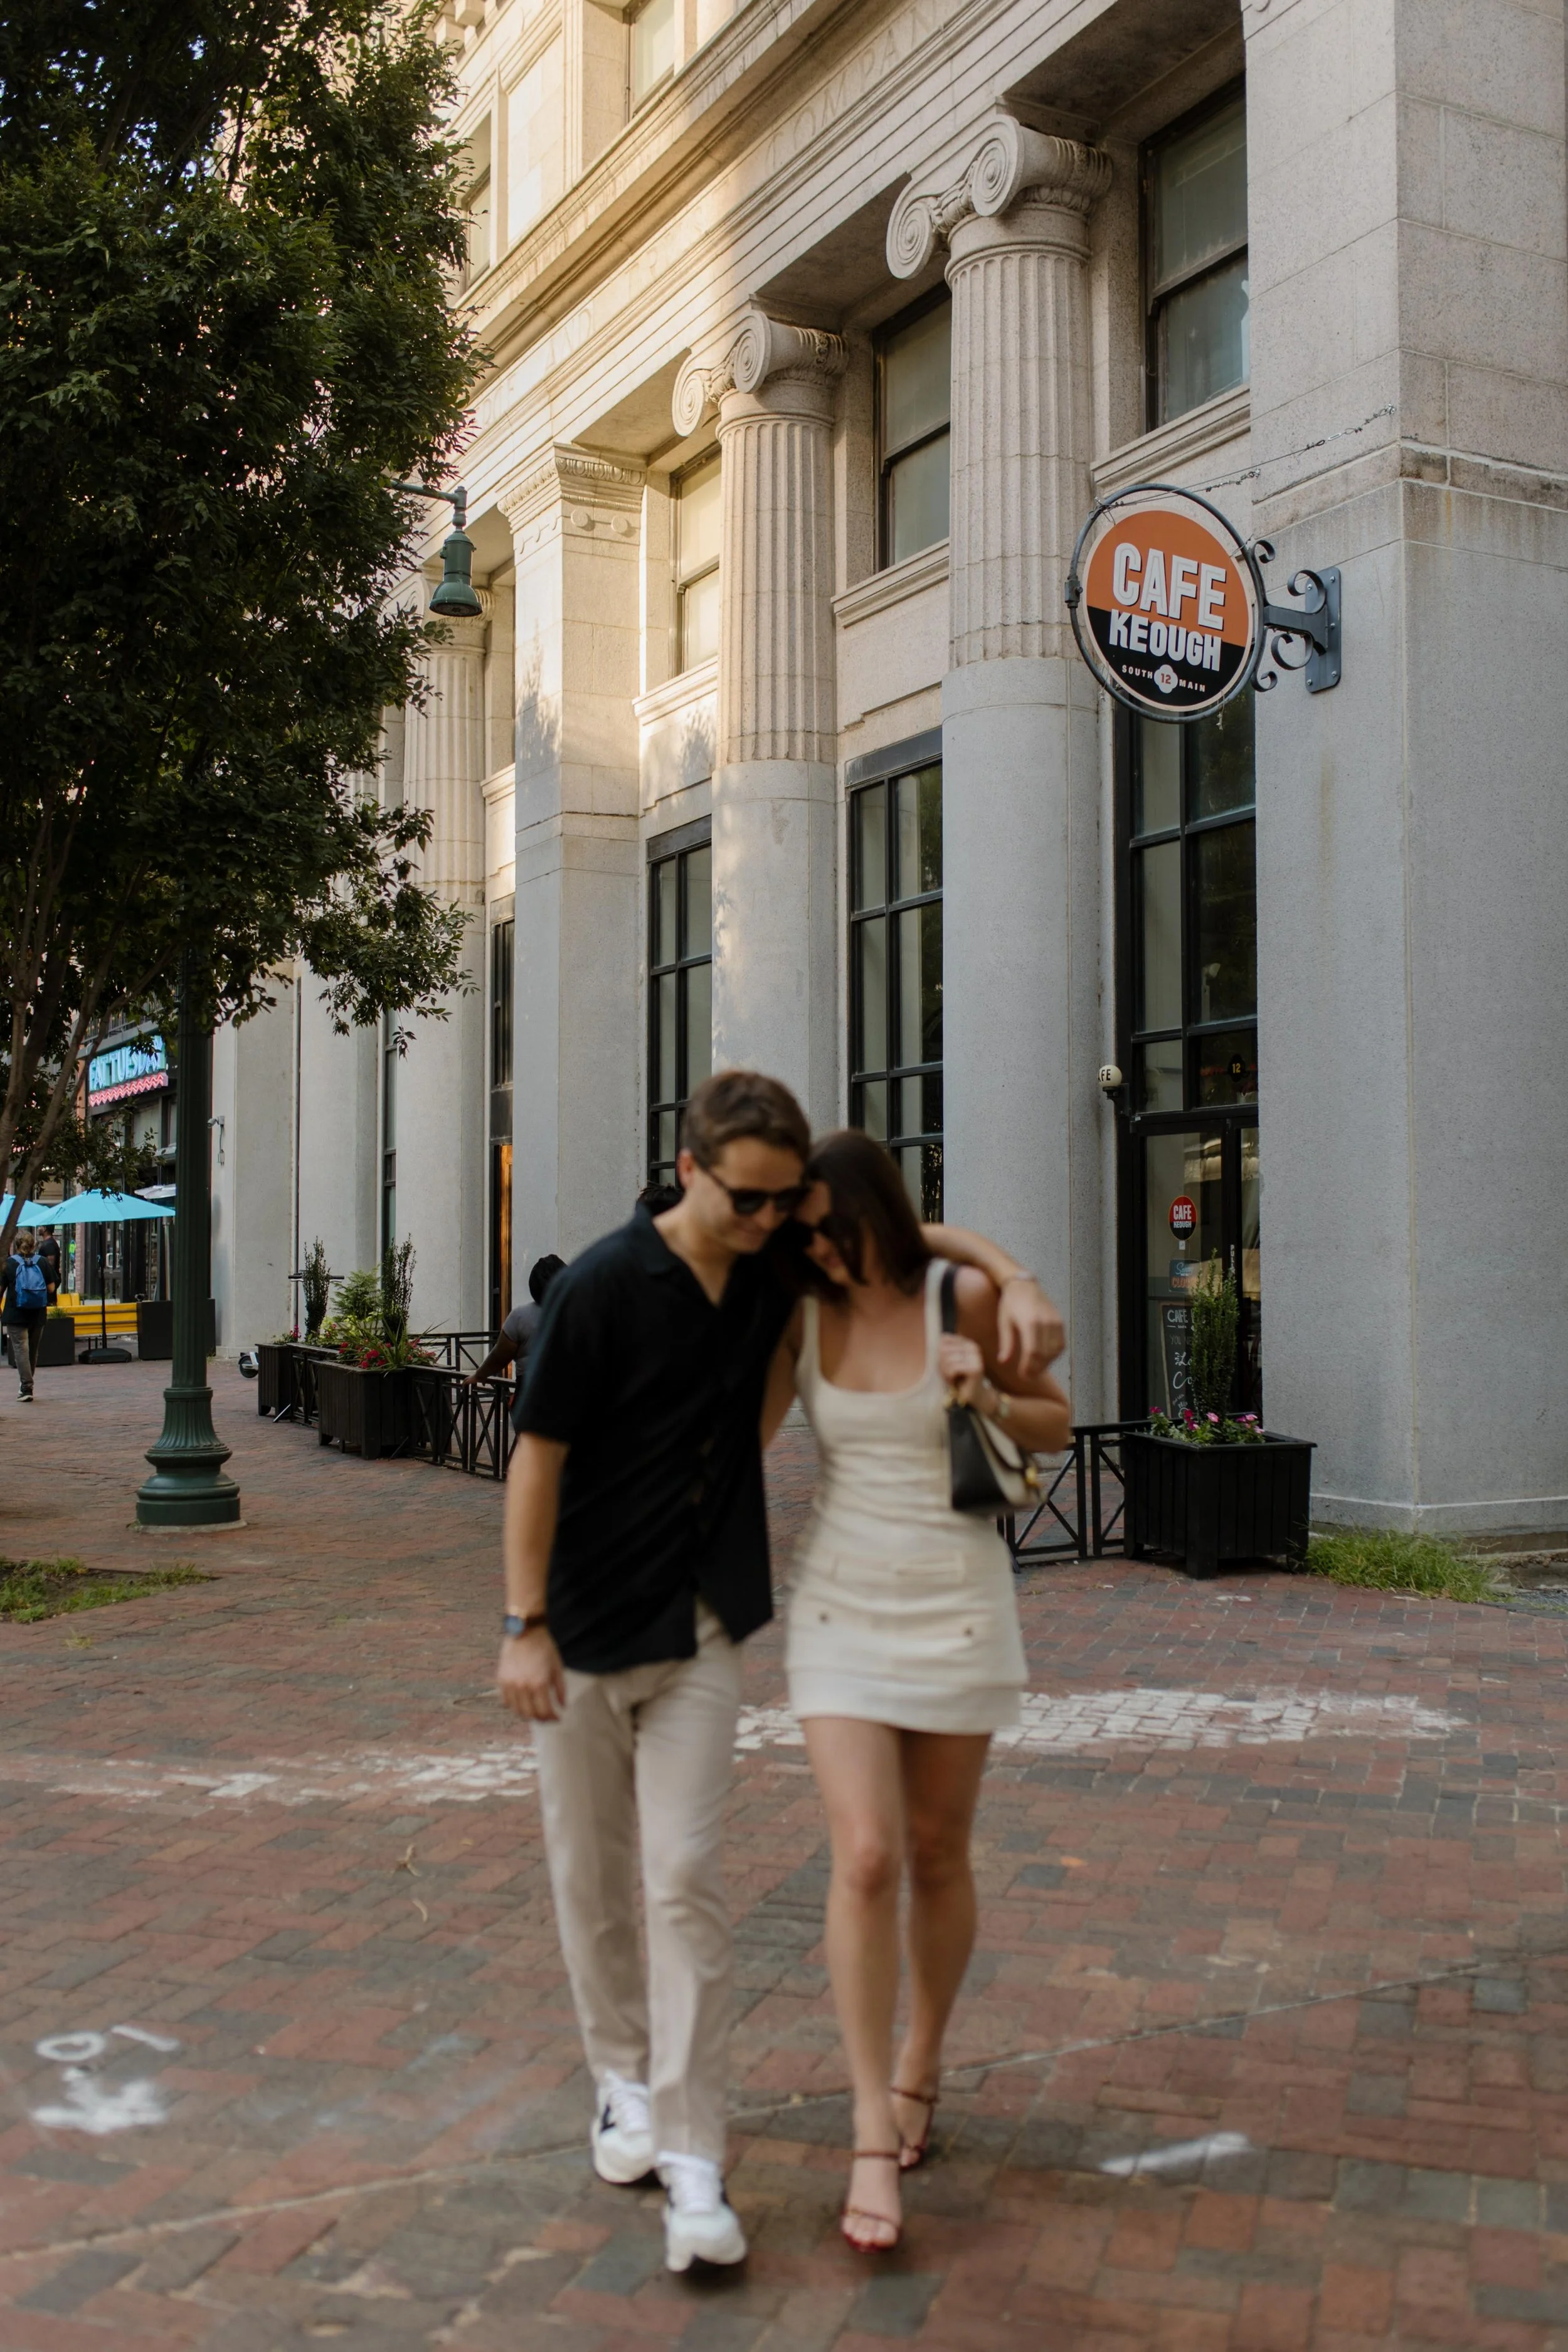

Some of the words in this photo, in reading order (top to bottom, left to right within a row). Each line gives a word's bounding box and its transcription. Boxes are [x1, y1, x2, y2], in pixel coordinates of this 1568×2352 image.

[1113, 543, 1226, 631] CAFE
[1109, 608, 1222, 672] KEOUGH
[1121, 664, 1153, 679] SOUTH
[1160, 673, 1172, 685] 12
[1179, 679, 1205, 692] MAIN
[89, 1055, 110, 1092] FAT
[1232, 1062, 1241, 1074] 12
[1173, 1205, 1192, 1220] CAFE
[1173, 1220, 1192, 1229] KEOUGH
[1167, 1309, 1189, 1323] CAFE
